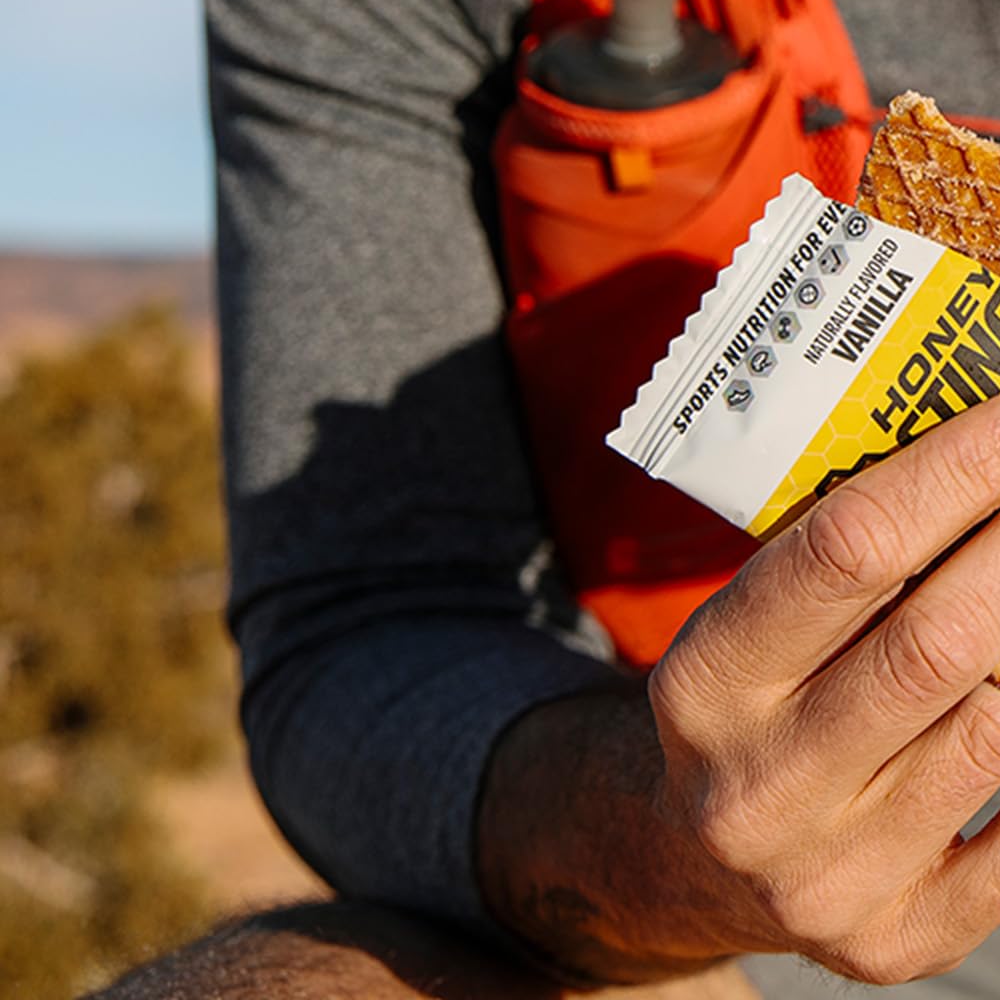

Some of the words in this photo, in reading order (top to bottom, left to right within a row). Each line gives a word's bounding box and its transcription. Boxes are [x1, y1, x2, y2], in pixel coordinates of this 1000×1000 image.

[672, 364, 728, 434] SPORTS
[723, 267, 797, 366] NUTRITION
[790, 232, 823, 272] FOR
[804, 295, 856, 364] NATURALLY
[849, 239, 898, 301] FLAVORED
[831, 267, 914, 363] VANILLA
[871, 265, 994, 433] HONEY
